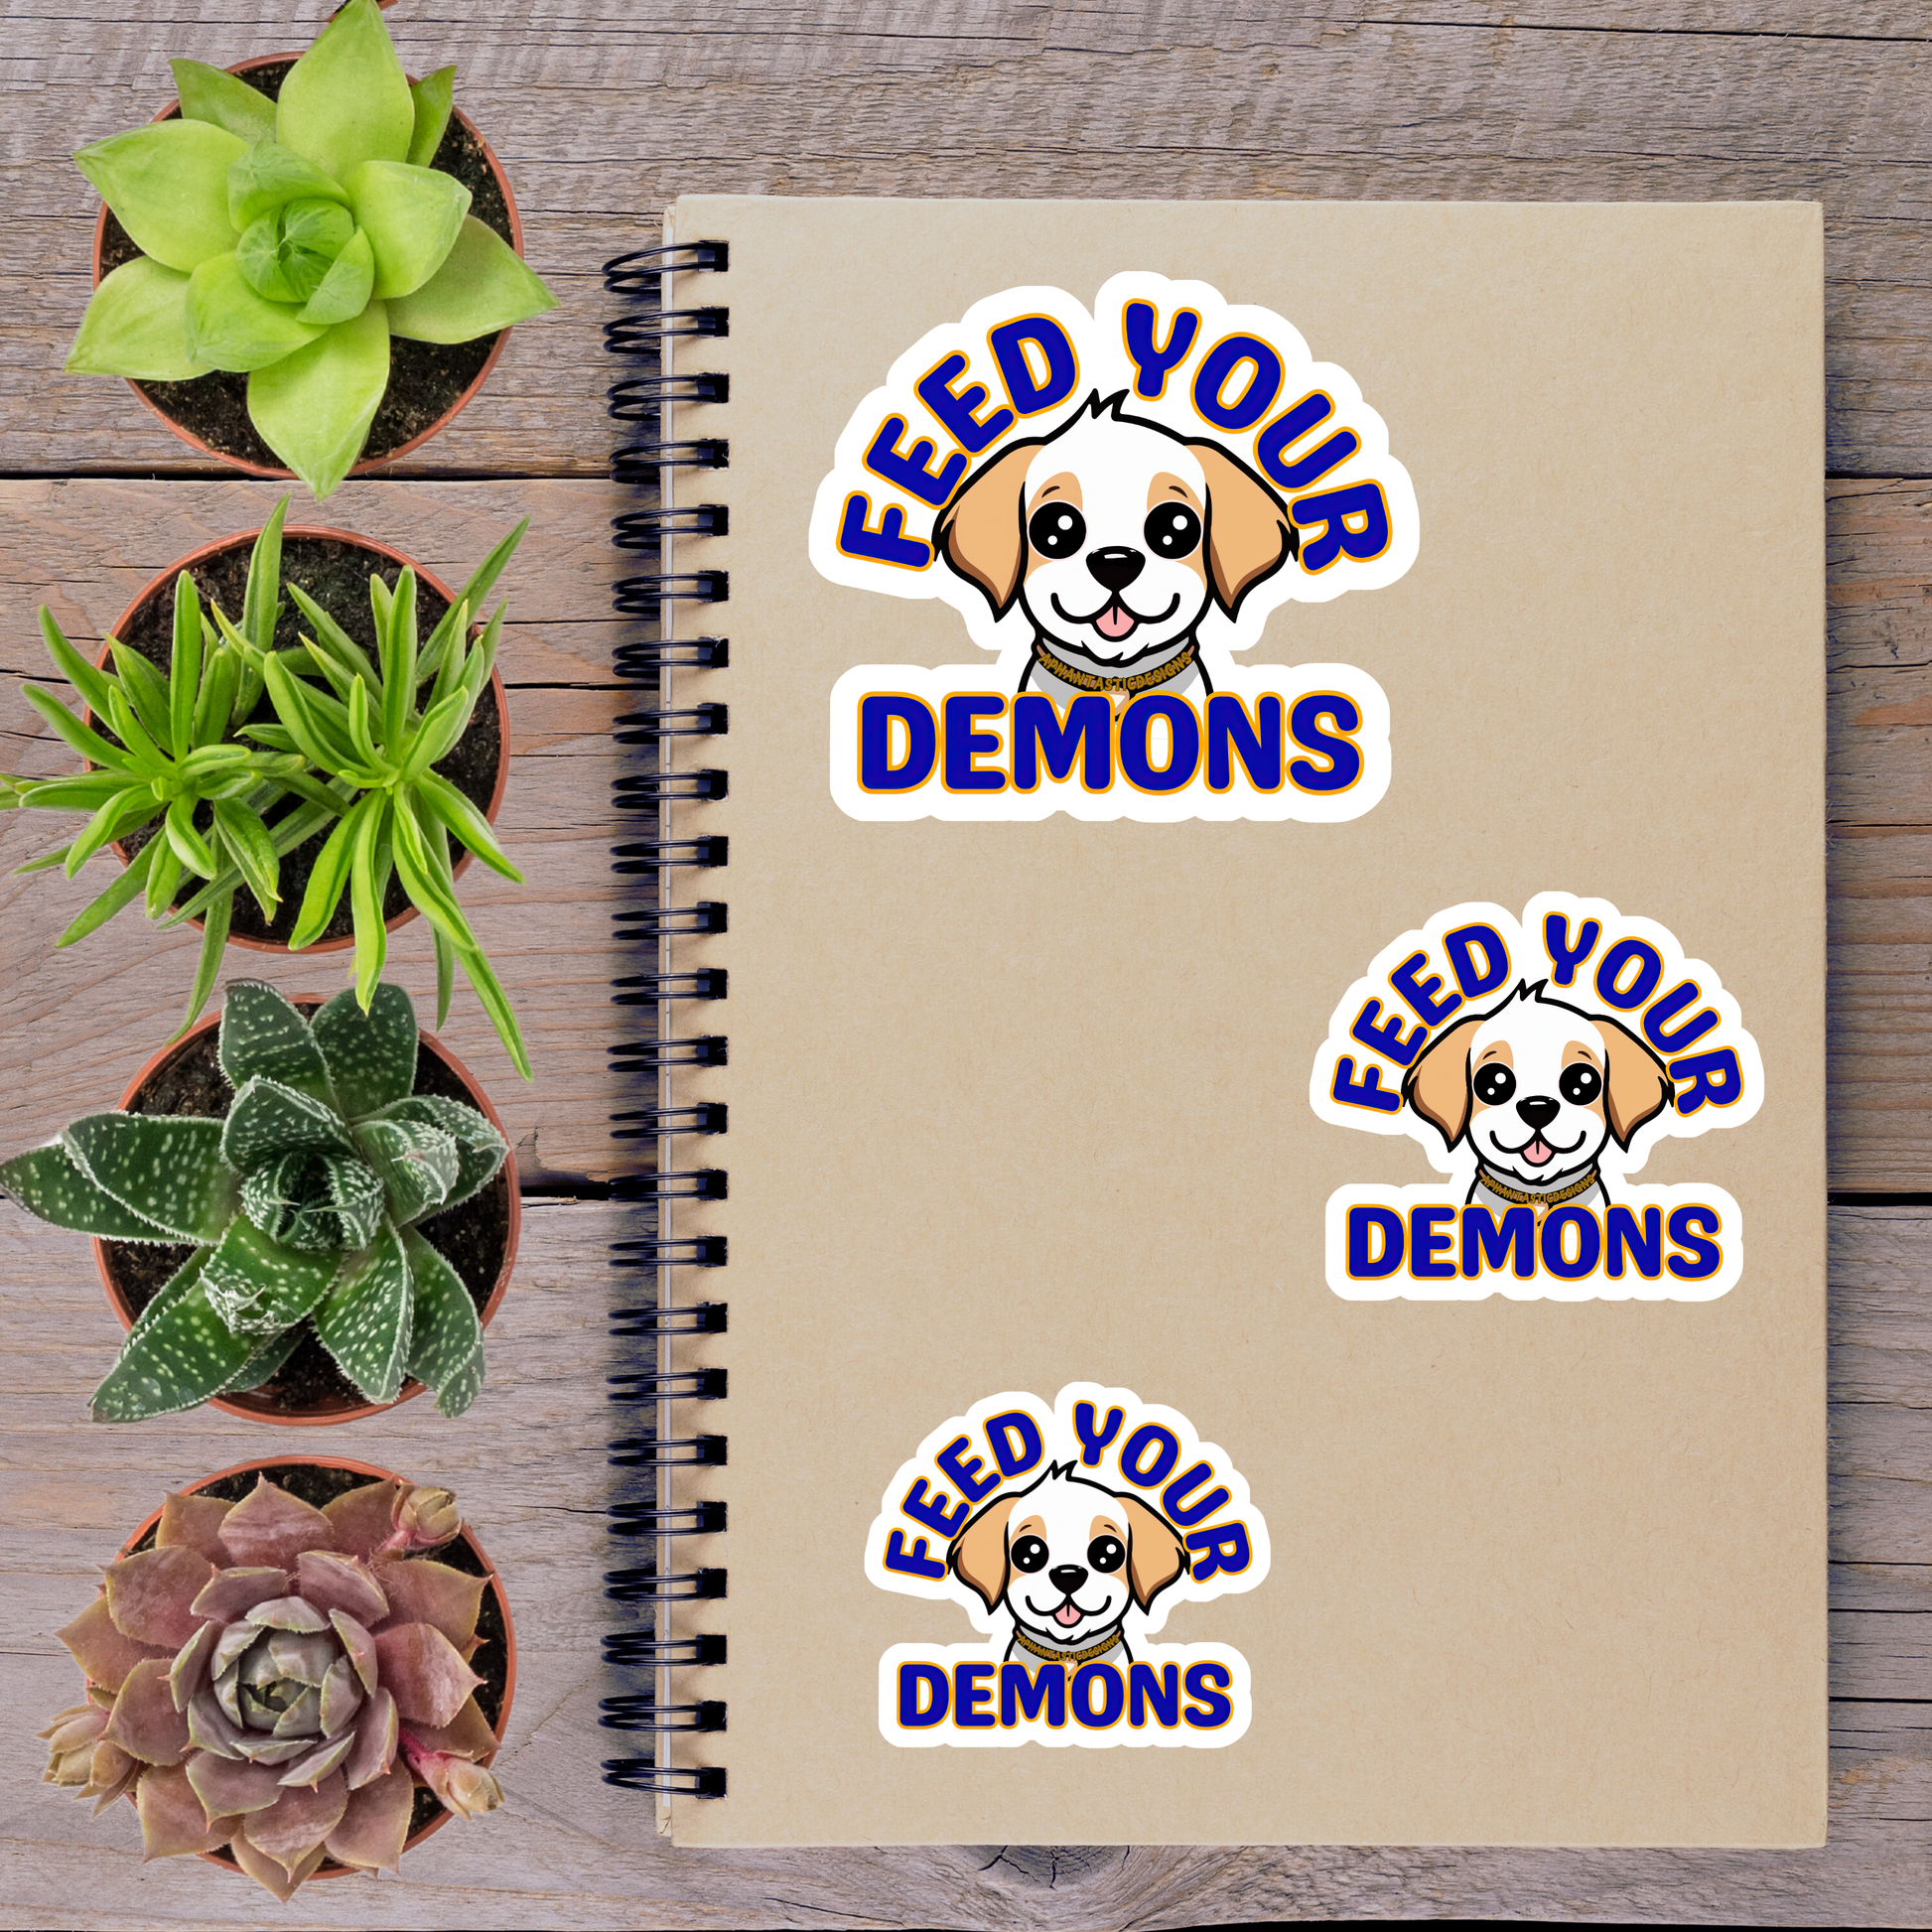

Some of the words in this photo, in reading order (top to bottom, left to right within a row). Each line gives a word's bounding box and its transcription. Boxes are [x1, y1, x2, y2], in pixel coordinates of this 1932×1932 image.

[837, 314, 1079, 571] FEED
[1123, 300, 1392, 574] YOUR
[1037, 652, 1192, 692] APHANTASTICDESIGNS
[858, 691, 1363, 794] DEMONS
[1330, 923, 1511, 1114] FEED
[1544, 912, 1743, 1117] YOUR
[1479, 1174, 1595, 1204] APHANTASTICDESIGNS
[1346, 1204, 1723, 1281] DEMONS
[883, 1410, 1044, 1582] FEED
[1073, 1400, 1252, 1584] YOUR
[1017, 1634, 1120, 1661] APHANTASTICDESIGNS
[897, 1661, 1233, 1729] DEMONS
